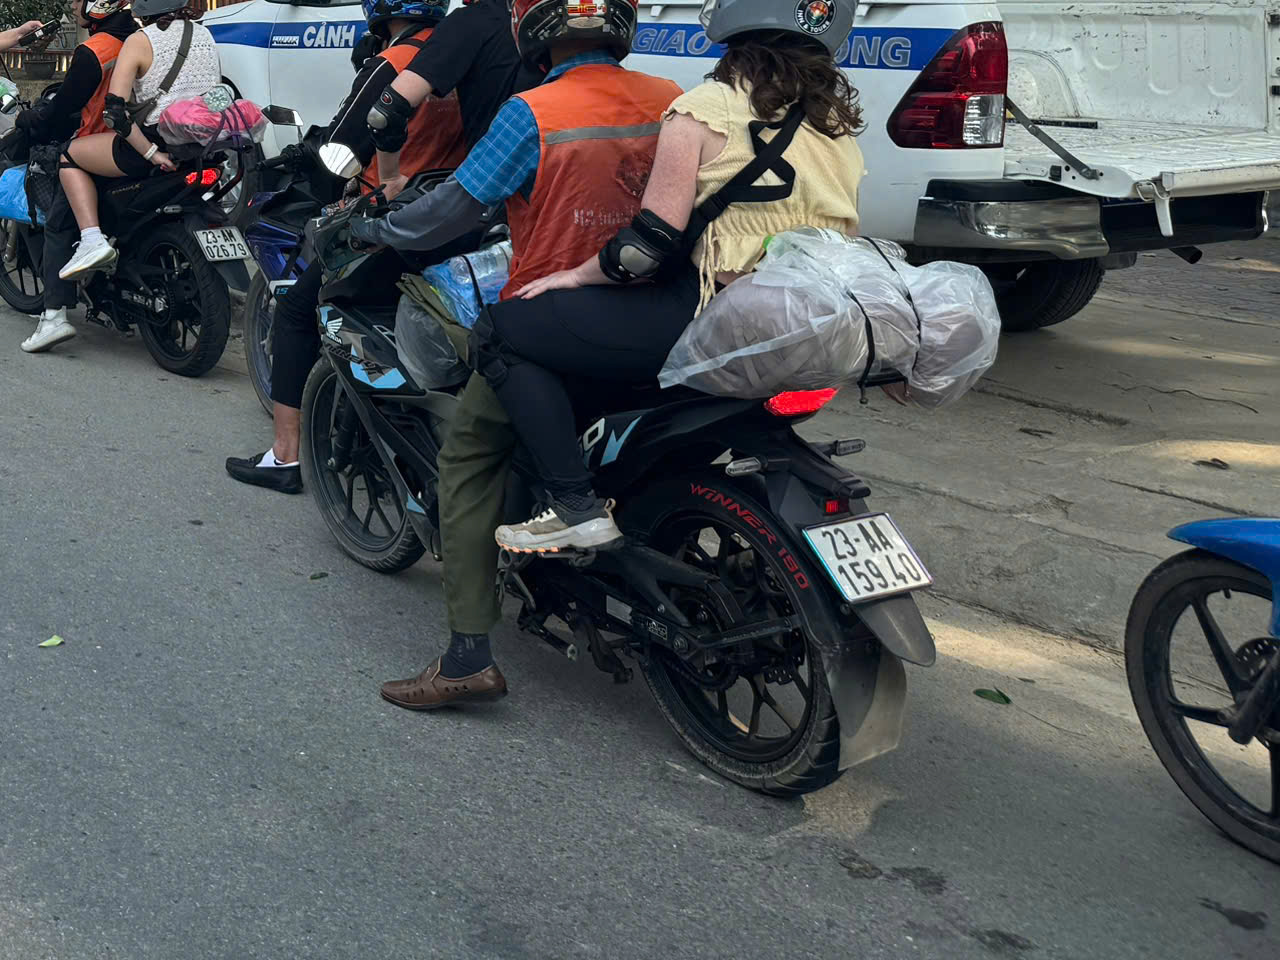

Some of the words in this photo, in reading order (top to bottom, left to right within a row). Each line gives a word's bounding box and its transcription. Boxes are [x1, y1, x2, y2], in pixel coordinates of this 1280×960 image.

[303, 21, 356, 48] CẢNH
[631, 28, 713, 56] GIAO
[202, 229, 236, 244] 23-AM
[205, 243, 247, 258] 026.79
[821, 520, 894, 560] 23-AA
[778, 547, 809, 589] 150
[837, 552, 922, 595] 159.40
